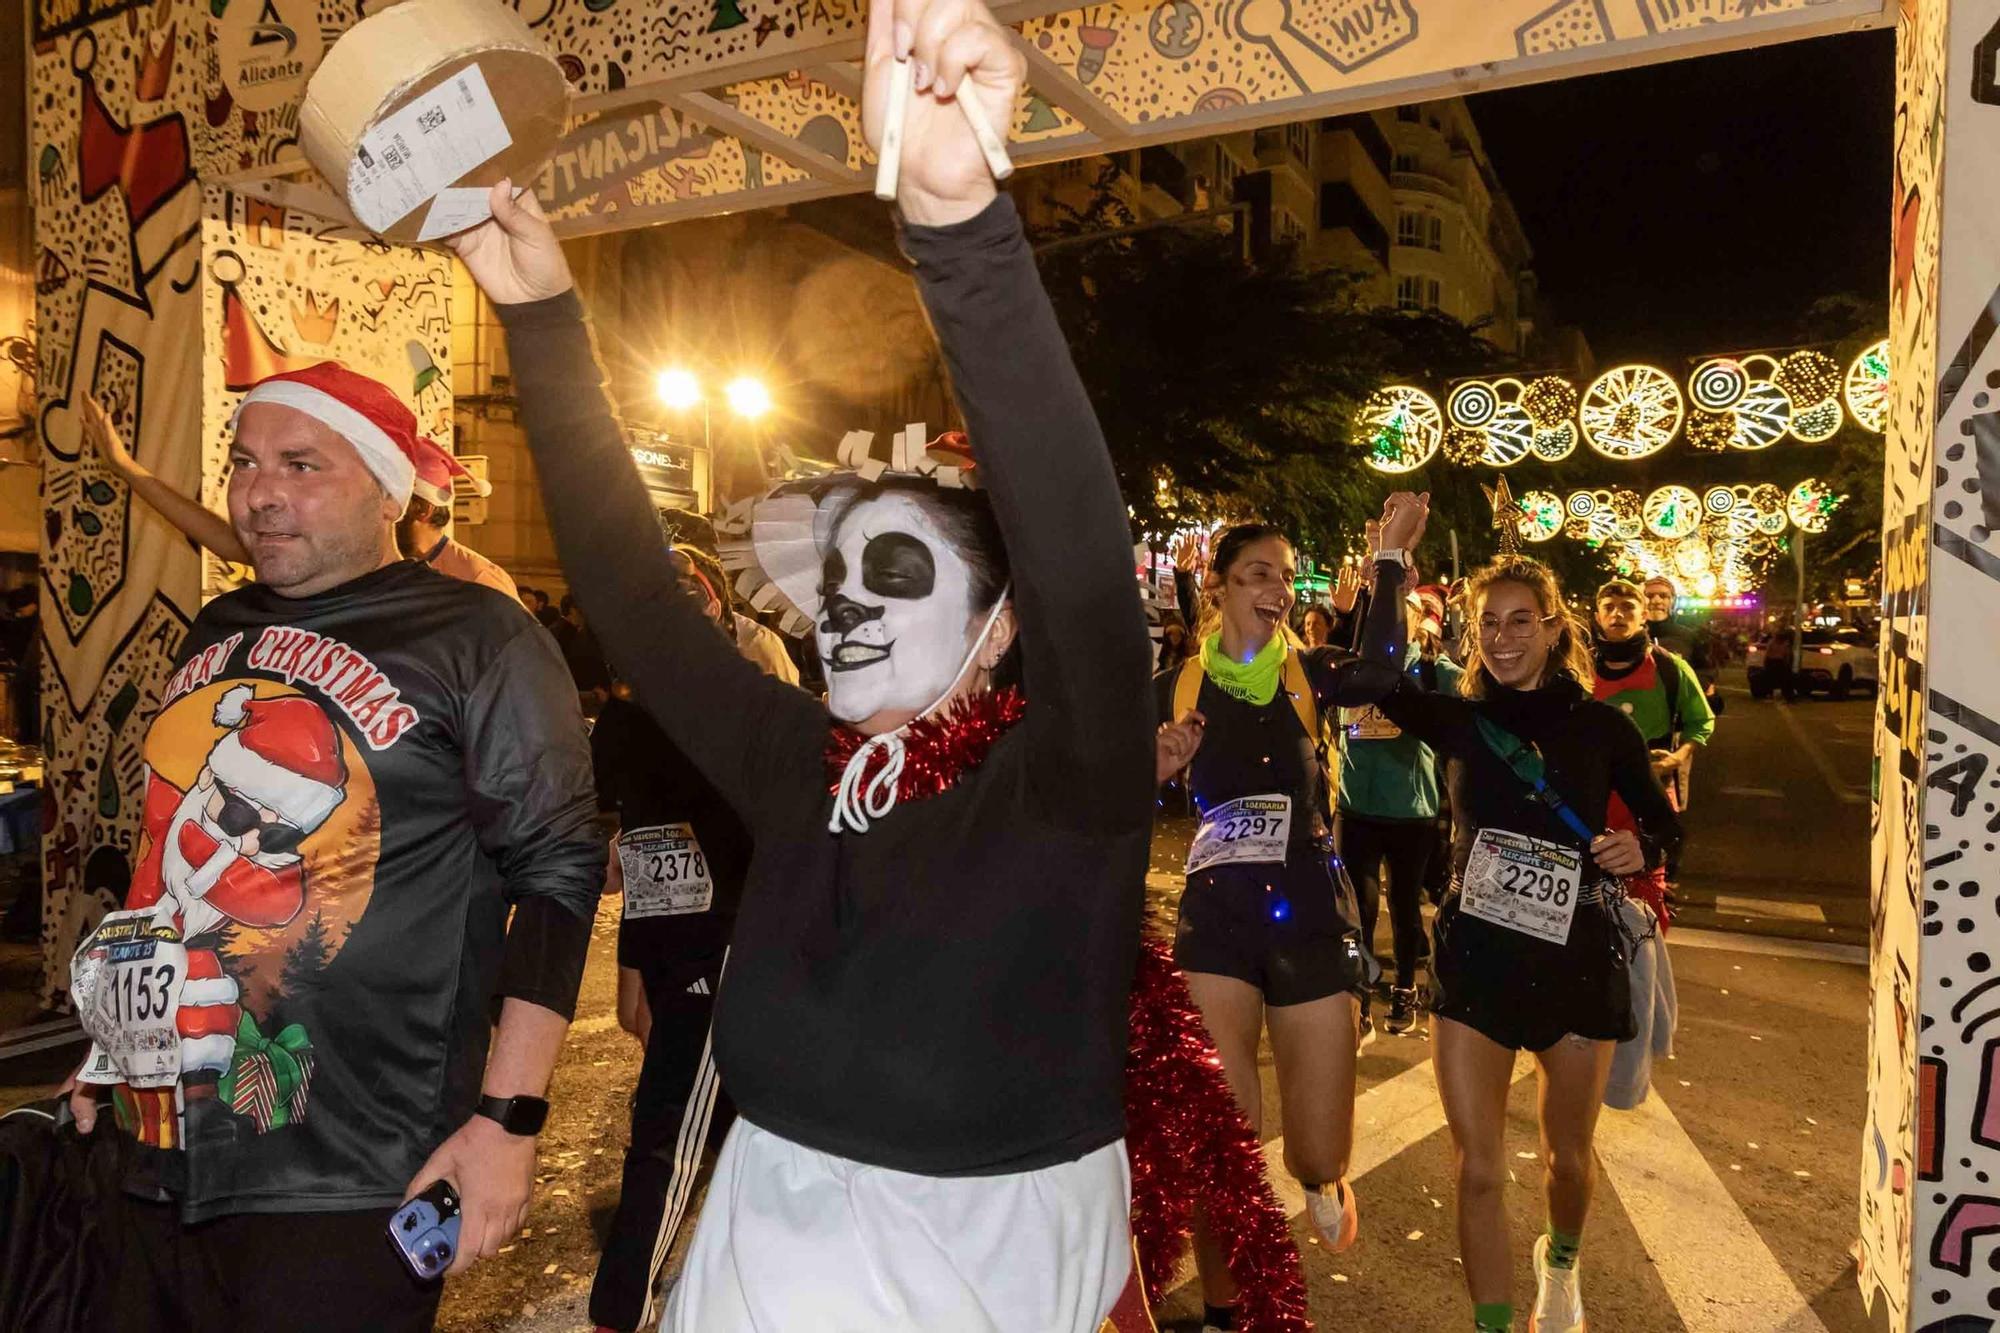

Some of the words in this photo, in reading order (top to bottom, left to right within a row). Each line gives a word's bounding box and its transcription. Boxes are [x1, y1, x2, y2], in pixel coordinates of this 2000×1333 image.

[239, 60, 304, 85] Alicante
[247, 626, 420, 750] CHRISTMAS
[1222, 817, 1283, 842] 2297
[651, 851, 705, 882] 2378
[1502, 865, 1571, 907] 2298
[109, 964, 176, 1022] 1153
